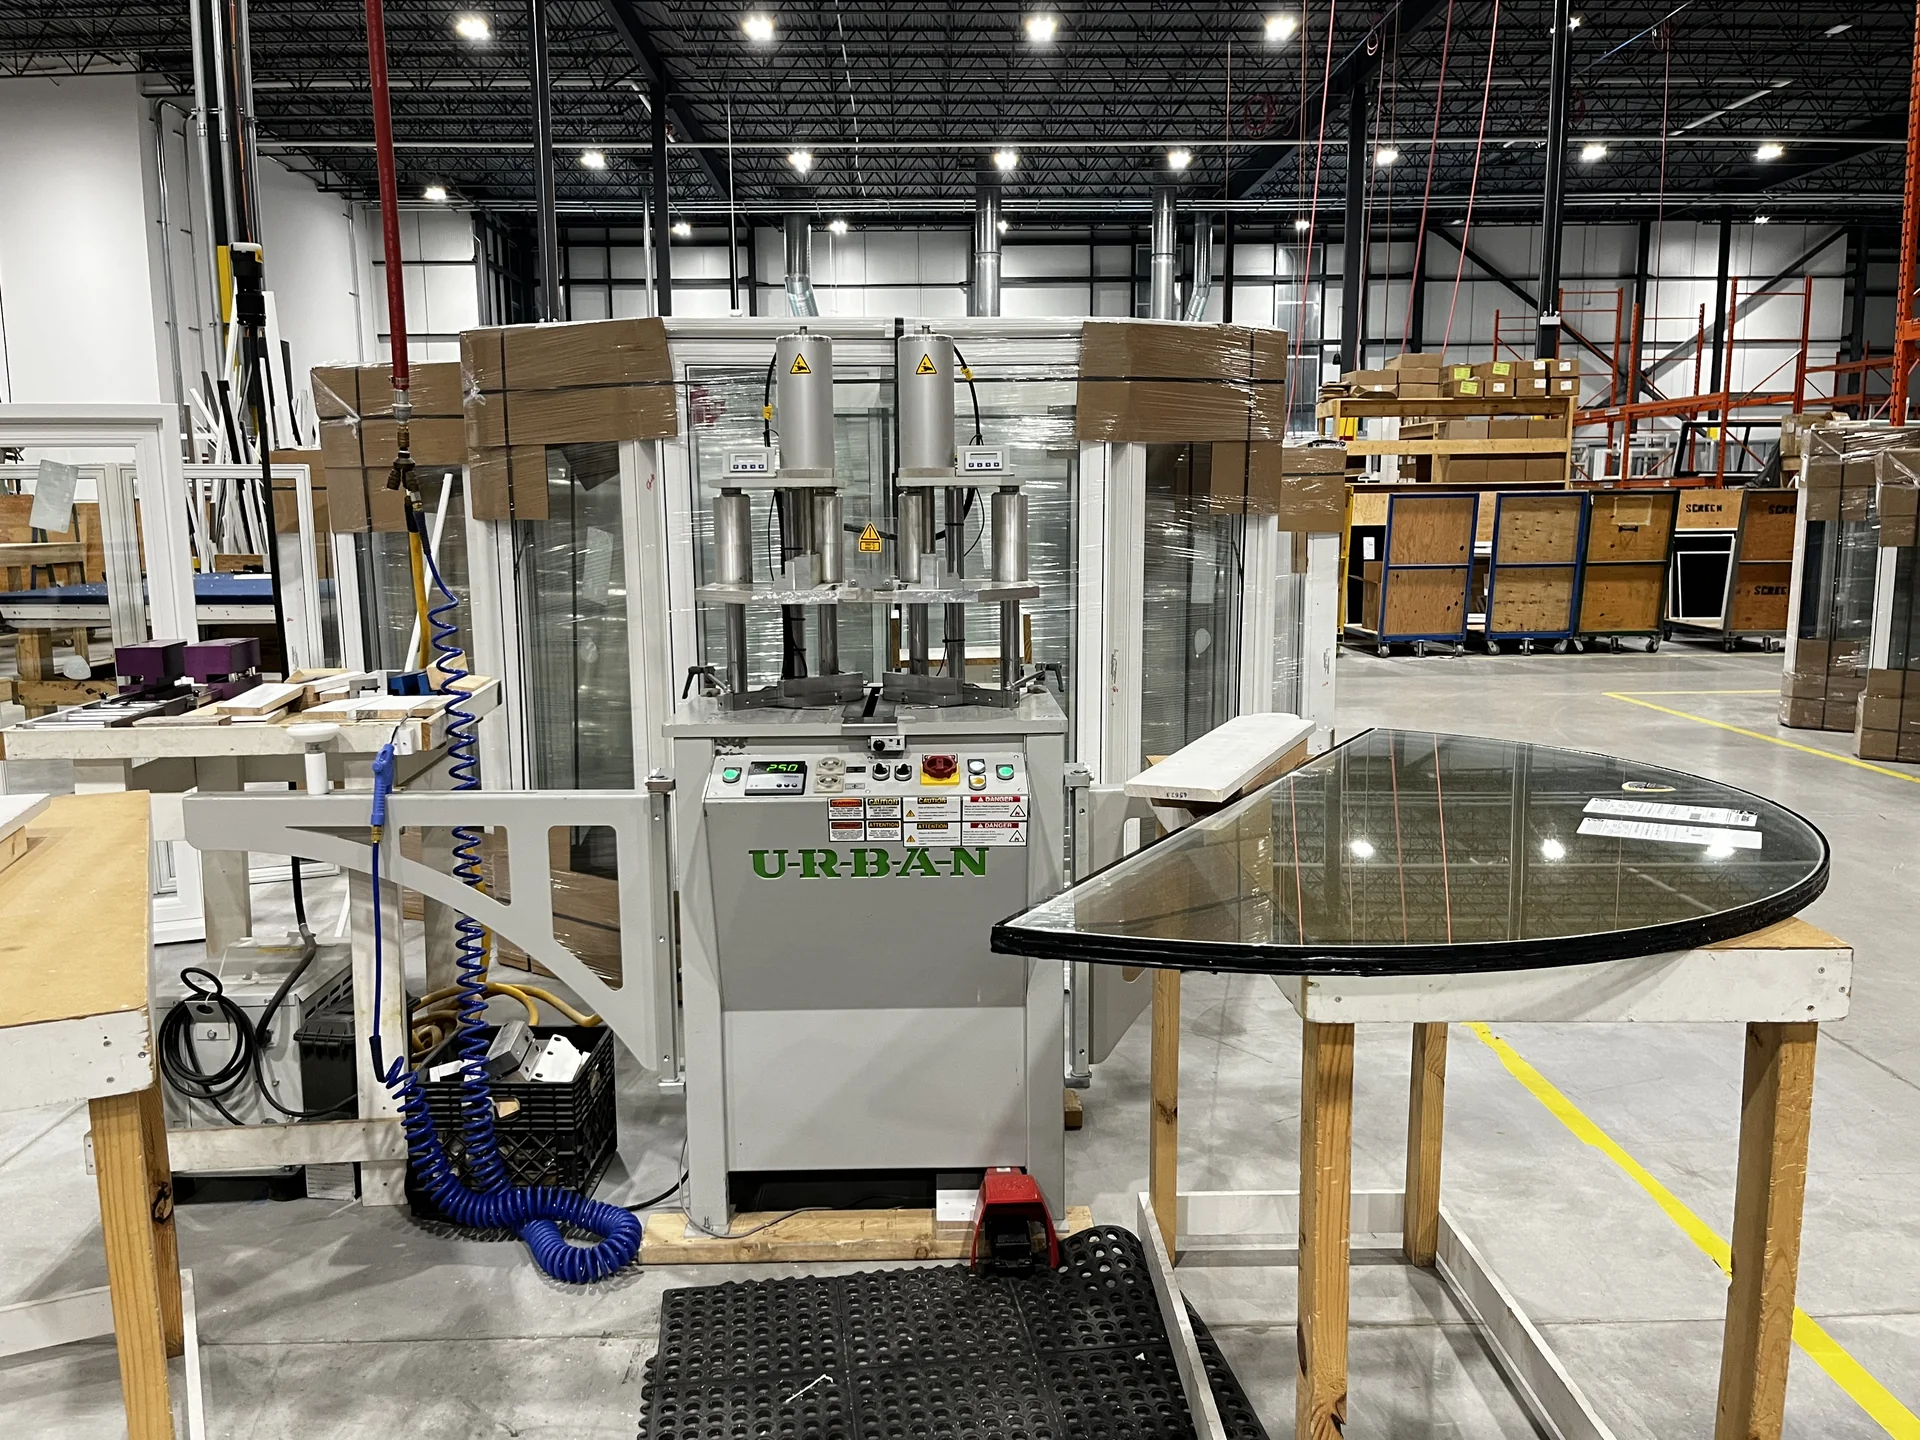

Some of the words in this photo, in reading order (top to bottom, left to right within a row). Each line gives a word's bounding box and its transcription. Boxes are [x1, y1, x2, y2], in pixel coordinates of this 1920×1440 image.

[1685, 504, 1723, 513] SCREEN
[1768, 505, 1797, 514] SCRE
[1754, 585, 1790, 595] SCREE
[766, 763, 799, 773] 250
[749, 848, 989, 879] U-R-B-A-N
